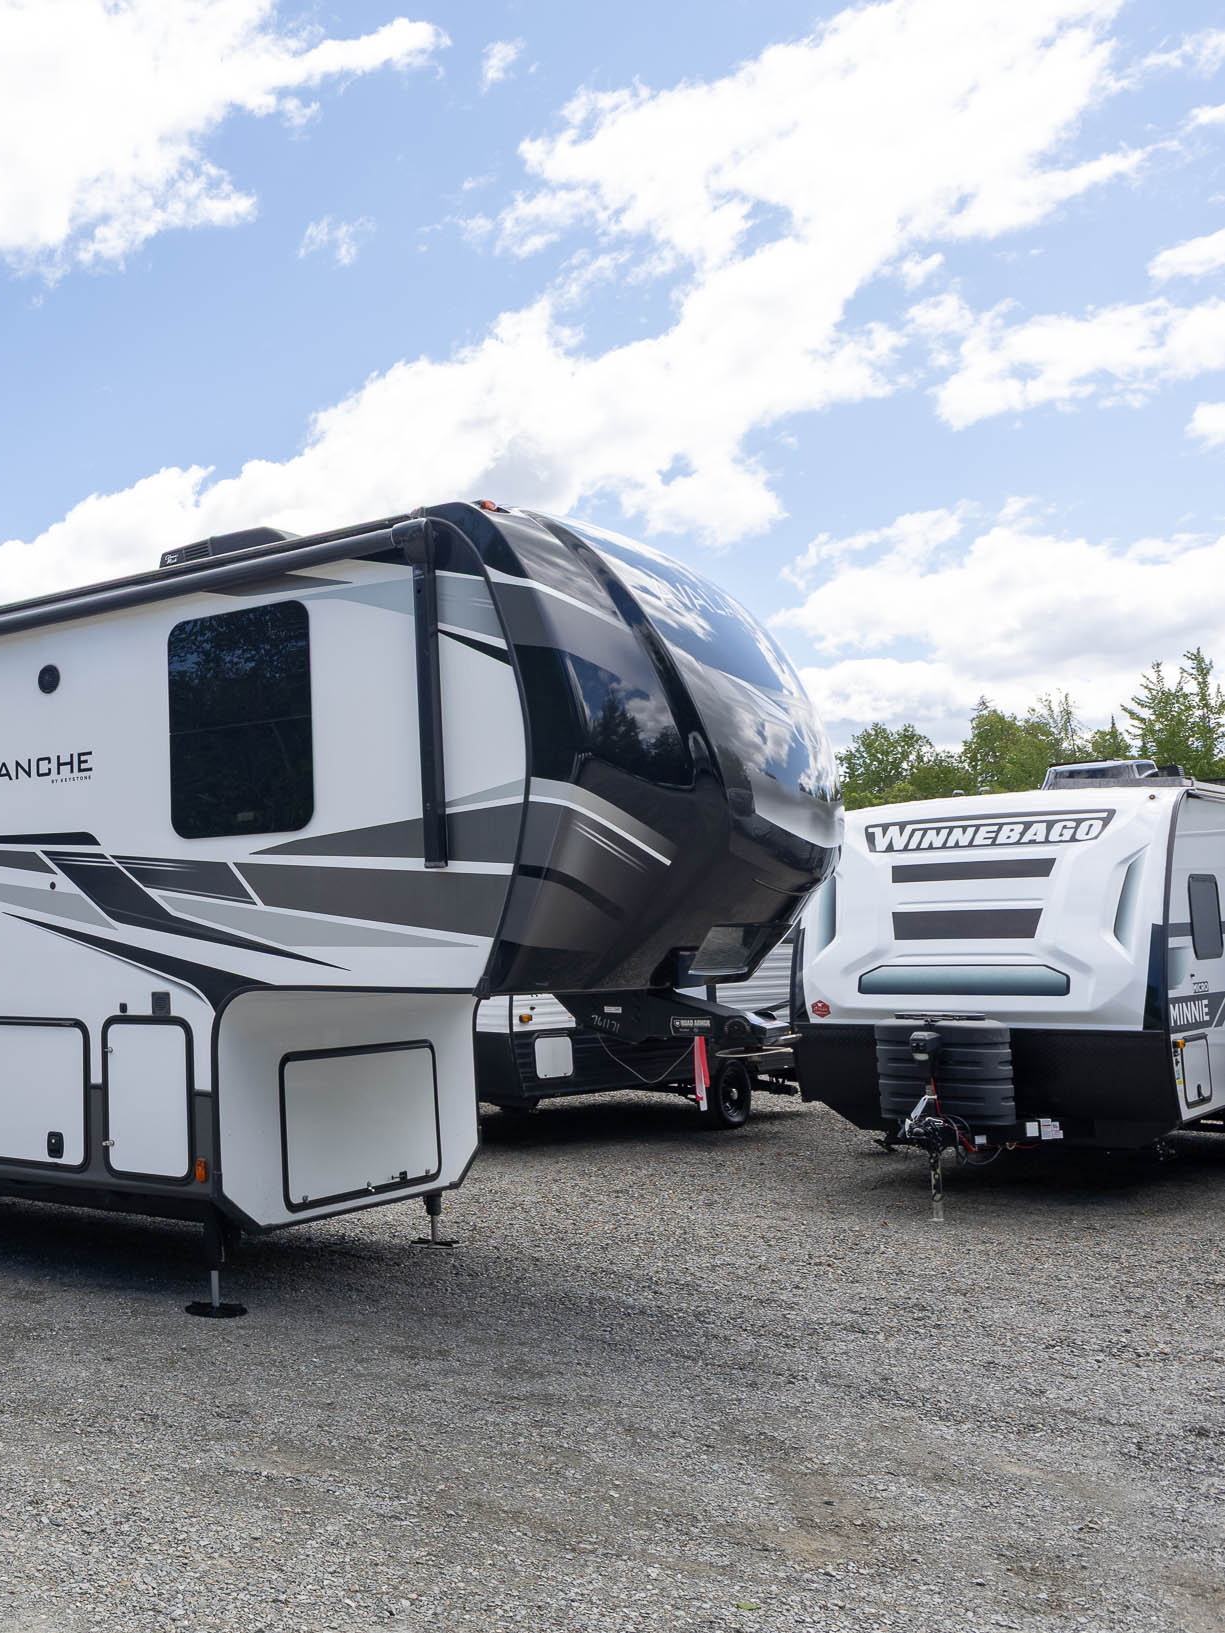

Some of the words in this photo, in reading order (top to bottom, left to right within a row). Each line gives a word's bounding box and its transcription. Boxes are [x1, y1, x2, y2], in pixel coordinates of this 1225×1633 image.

[60, 775, 92, 783] KEYSTONE
[867, 818, 1104, 852] WINNEBAGO
[1193, 982, 1209, 993] MICRO
[1170, 999, 1210, 1027] MINNIE
